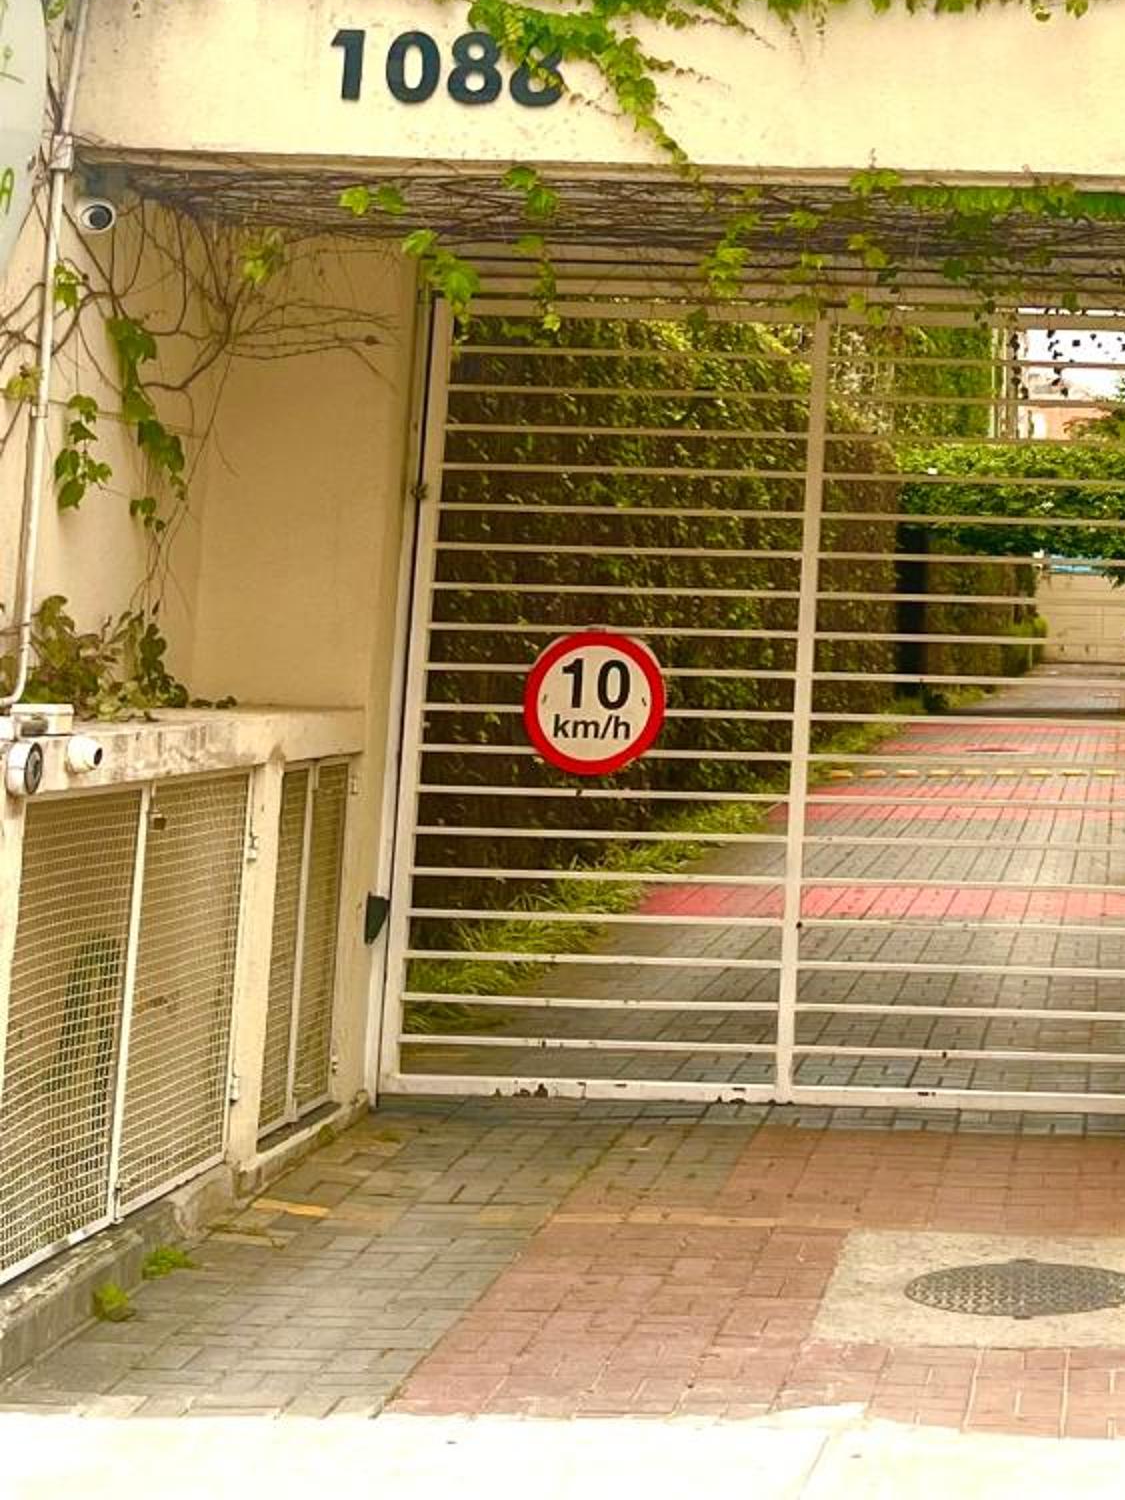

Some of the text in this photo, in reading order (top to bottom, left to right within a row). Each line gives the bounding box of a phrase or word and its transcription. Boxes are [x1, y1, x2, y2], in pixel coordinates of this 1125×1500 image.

[331, 29, 564, 107] 1088
[562, 657, 631, 710] 10
[553, 714, 631, 739] km/h
